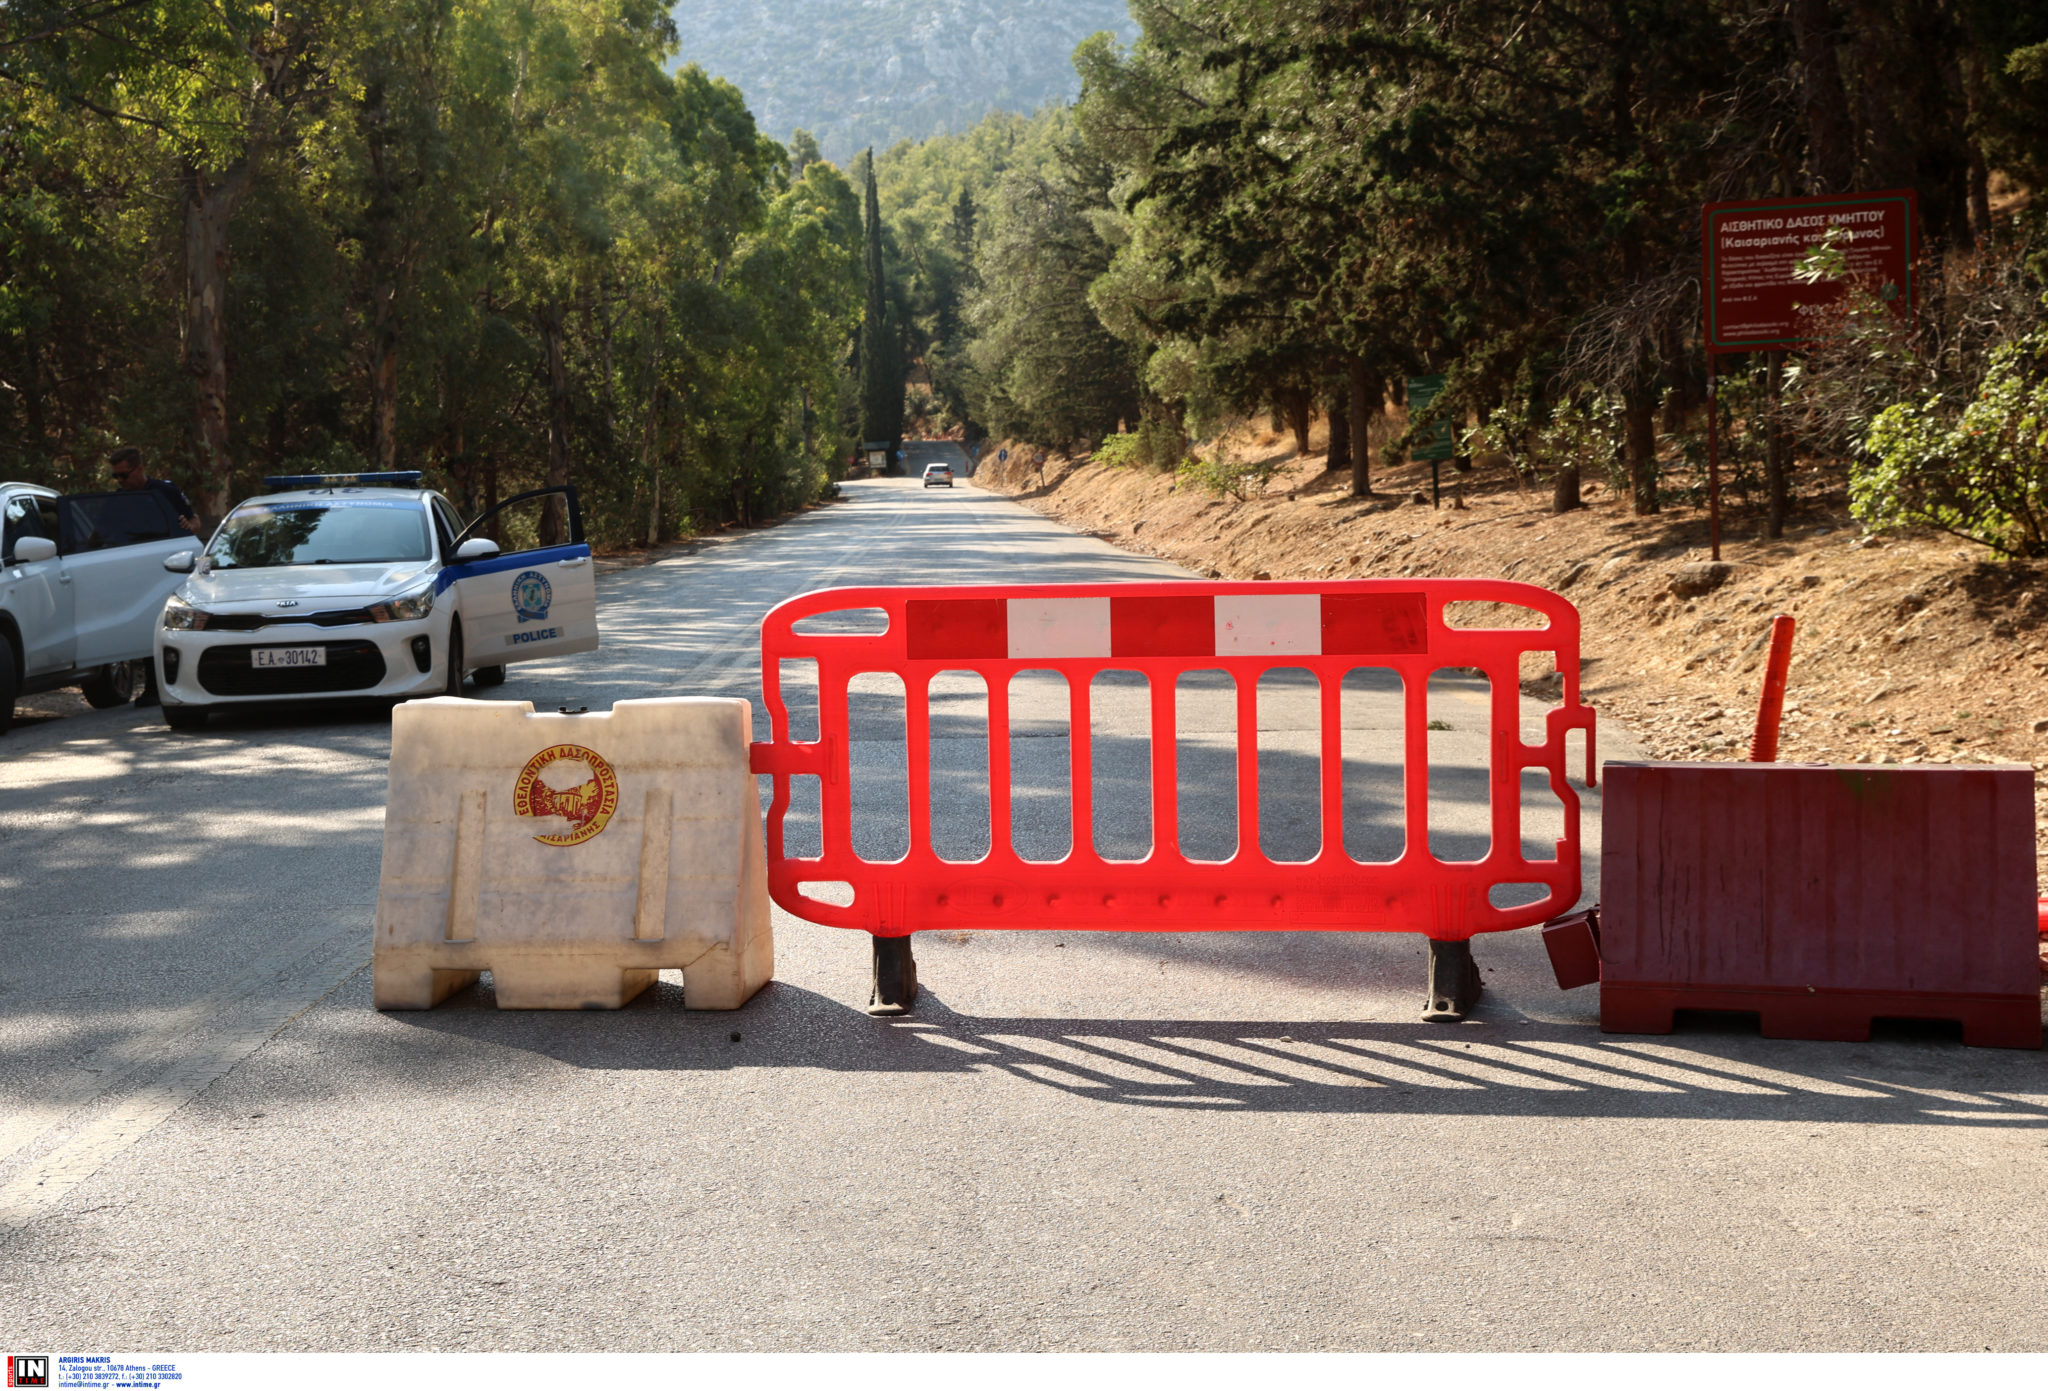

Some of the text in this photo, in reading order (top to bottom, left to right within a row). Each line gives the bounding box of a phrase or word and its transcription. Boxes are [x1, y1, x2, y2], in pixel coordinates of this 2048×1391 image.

[1720, 210, 1885, 233] ΑΙΣΘΗΤΙΚΟ ΔΑΣΟΣ ΥΜΗΤΤΟΥ
[1721, 233, 1800, 249] (Καισαριανής
[513, 627, 557, 644] POLICE
[284, 649, 318, 665] 30142
[516, 747, 617, 816] ΕΘΕΛΟΝΤΙΚΗ ΔΑΣΟΠΡΟΣΤΑΣΙΑ
[540, 821, 601, 842] ΑΙΣΑΡΙΑΝΗΣ
